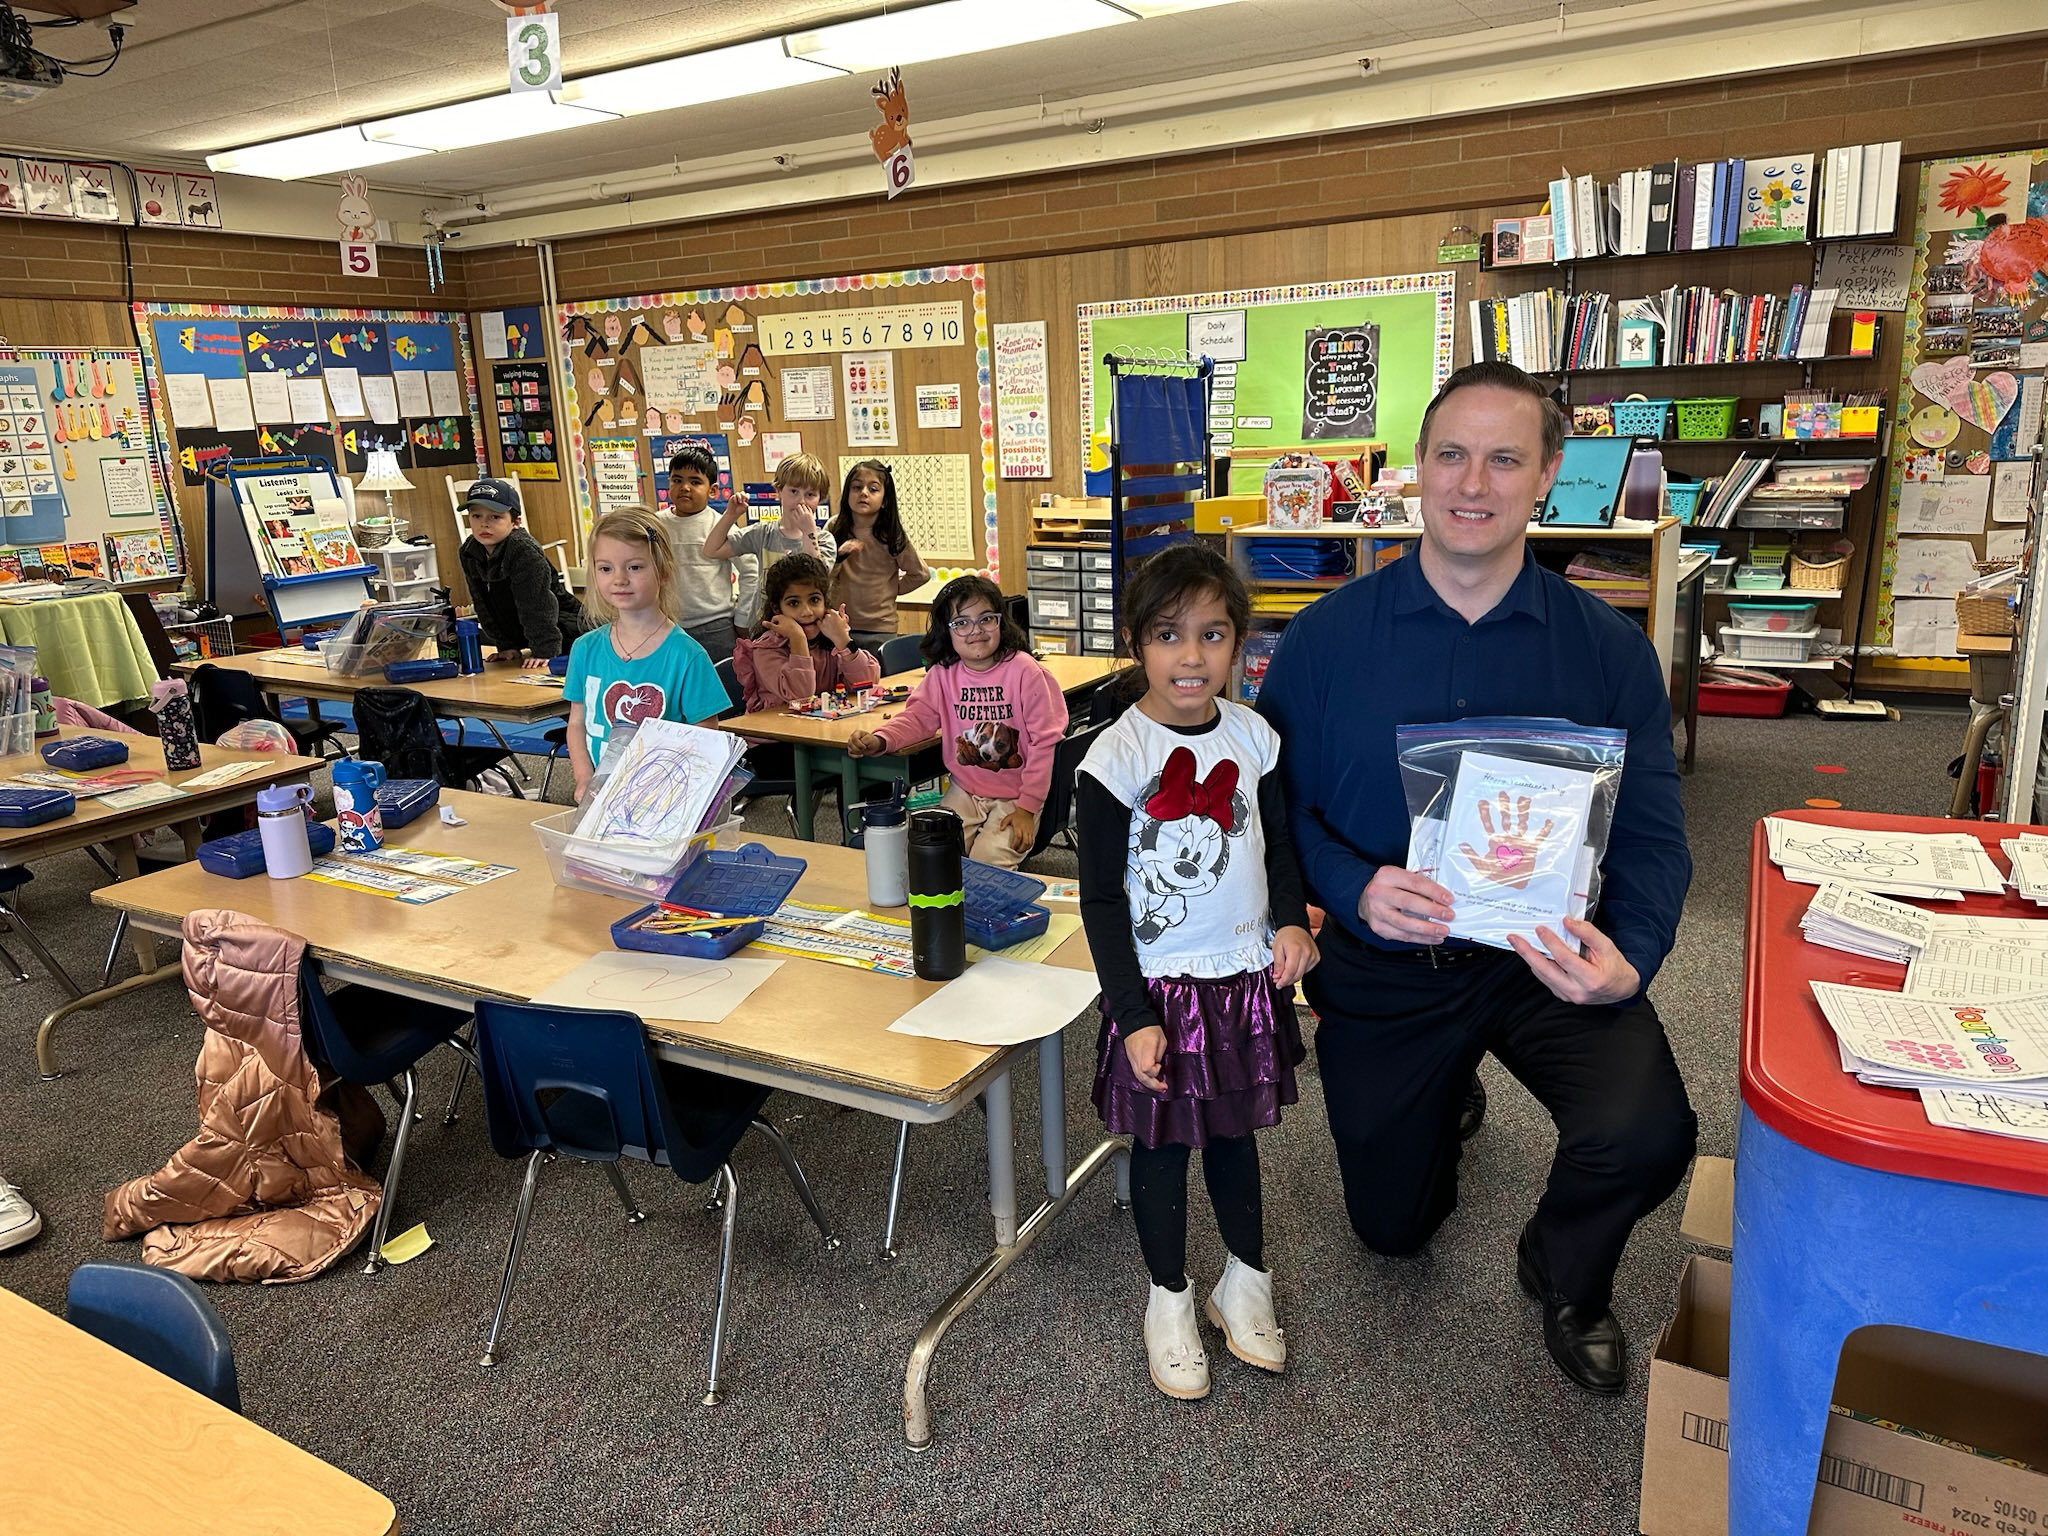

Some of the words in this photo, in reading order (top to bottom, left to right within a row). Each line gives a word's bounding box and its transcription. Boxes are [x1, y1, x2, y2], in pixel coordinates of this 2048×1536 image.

[519, 24, 551, 85] 3
[26, 163, 63, 185] Ww
[892, 154, 910, 188] 6
[143, 175, 166, 198] Yy
[187, 179, 208, 198] Zz
[349, 246, 371, 273] 5
[1207, 321, 1226, 331] Daily
[768, 333, 774, 351] 1
[784, 331, 795, 349] 2
[803, 330, 814, 348] 3
[822, 328, 833, 347] 4
[842, 327, 852, 346] 5
[862, 326, 872, 345] 6
[881, 325, 892, 344] 7
[902, 323, 913, 343] 8
[923, 322, 933, 342] 9
[942, 320, 958, 341] 10
[1200, 335, 1234, 346] Schedule
[1319, 340, 1365, 354] THINK
[1008, 362, 1044, 376] YOURSELF
[1328, 362, 1358, 372] True?
[503, 370, 522, 380] Helping
[522, 369, 540, 378] Hands
[1328, 373, 1366, 384] Helpful?
[1009, 385, 1035, 395] Heart
[1000, 395, 1044, 406] NOTHING
[1327, 394, 1371, 406] Necessary?
[1327, 406, 1354, 416] Kind?
[1015, 422, 1046, 437] BIG
[591, 442, 604, 450] Days
[620, 440, 636, 449] Week
[1002, 445, 1047, 455] possibility
[603, 463, 626, 471] Monday
[1006, 465, 1044, 477] HAPPY
[259, 477, 299, 487] Listening
[604, 473, 628, 482] Tuesday
[601, 483, 634, 492] Wednesday
[606, 493, 632, 501] Thursday
[750, 506, 758, 518] 11
[761, 506, 769, 517] 12
[819, 506, 828, 516] 17
[128, 544, 148, 552] Loved
[960, 686, 1005, 702] BETTER
[953, 704, 1014, 721] TOGETHER
[1847, 891, 1931, 923] Friends
[763, 935, 784, 944] ack
[795, 940, 858, 955] Hartman
[1952, 1506, 1991, 1529] 2024
[1993, 1499, 2038, 1526] 05105
[1903, 1512, 1946, 1534] FREEZE
